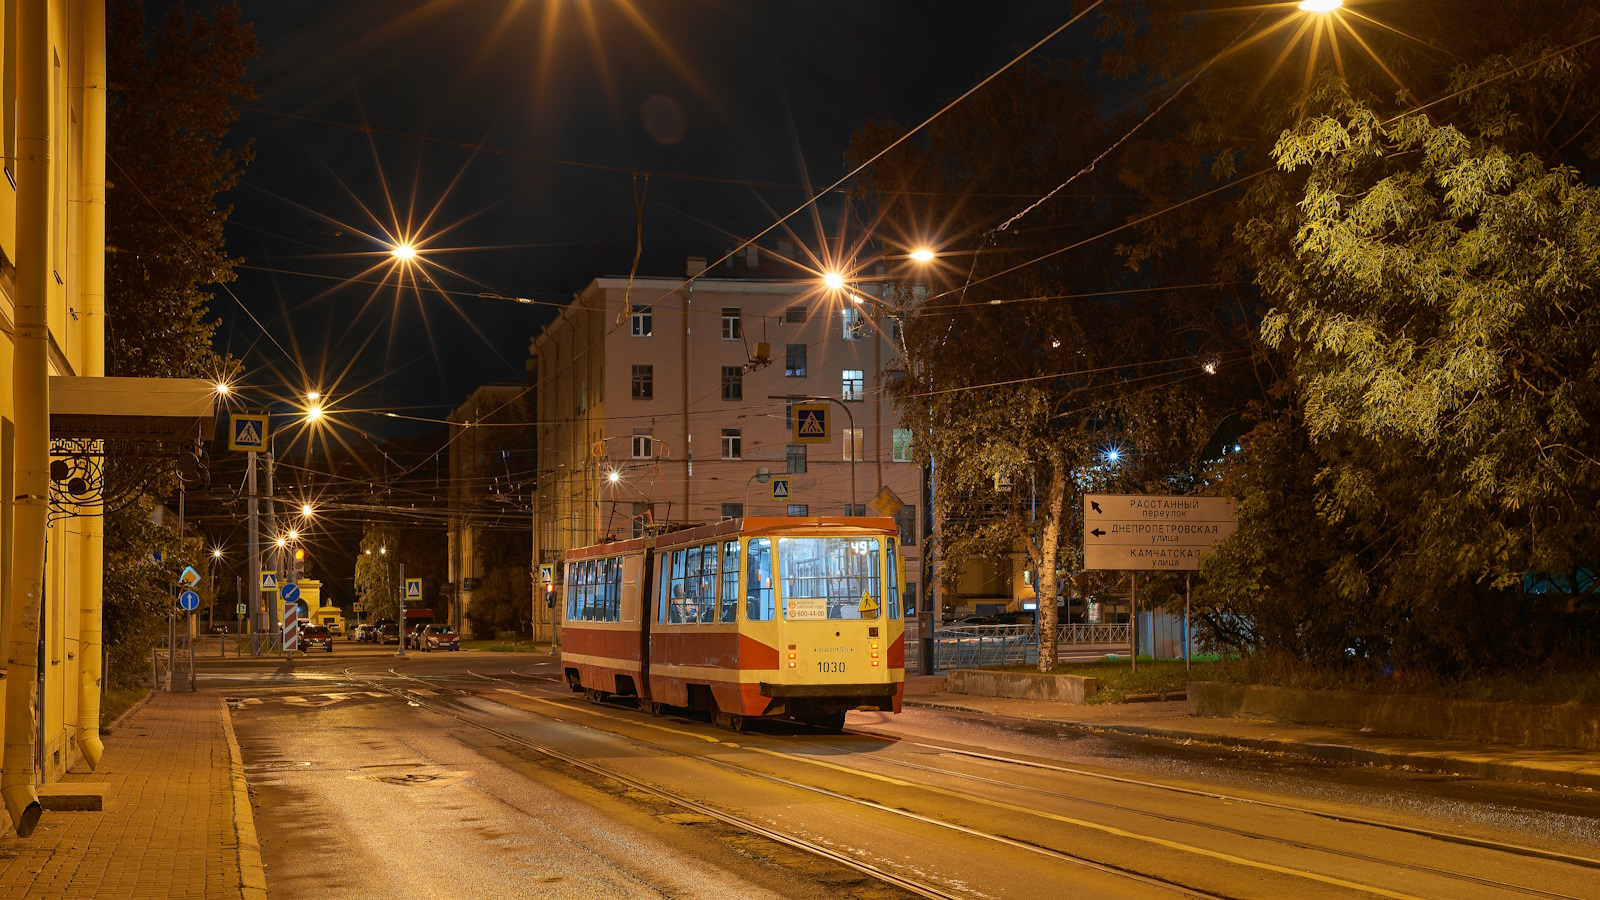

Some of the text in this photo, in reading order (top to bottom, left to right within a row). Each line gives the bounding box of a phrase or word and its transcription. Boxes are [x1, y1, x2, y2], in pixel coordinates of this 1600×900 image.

[1130, 499, 1199, 508] РАССТАННЫЙ
[1142, 510, 1187, 518] переулок
[1112, 524, 1218, 534] ДНЕПРОПЕТРОВСКАЯ
[1152, 535, 1179, 543] улица
[851, 540, 868, 555] 49
[1130, 550, 1200, 558] КАМЧАТСКАЯ
[1152, 560, 1180, 568] улица
[817, 661, 846, 672] 1030
